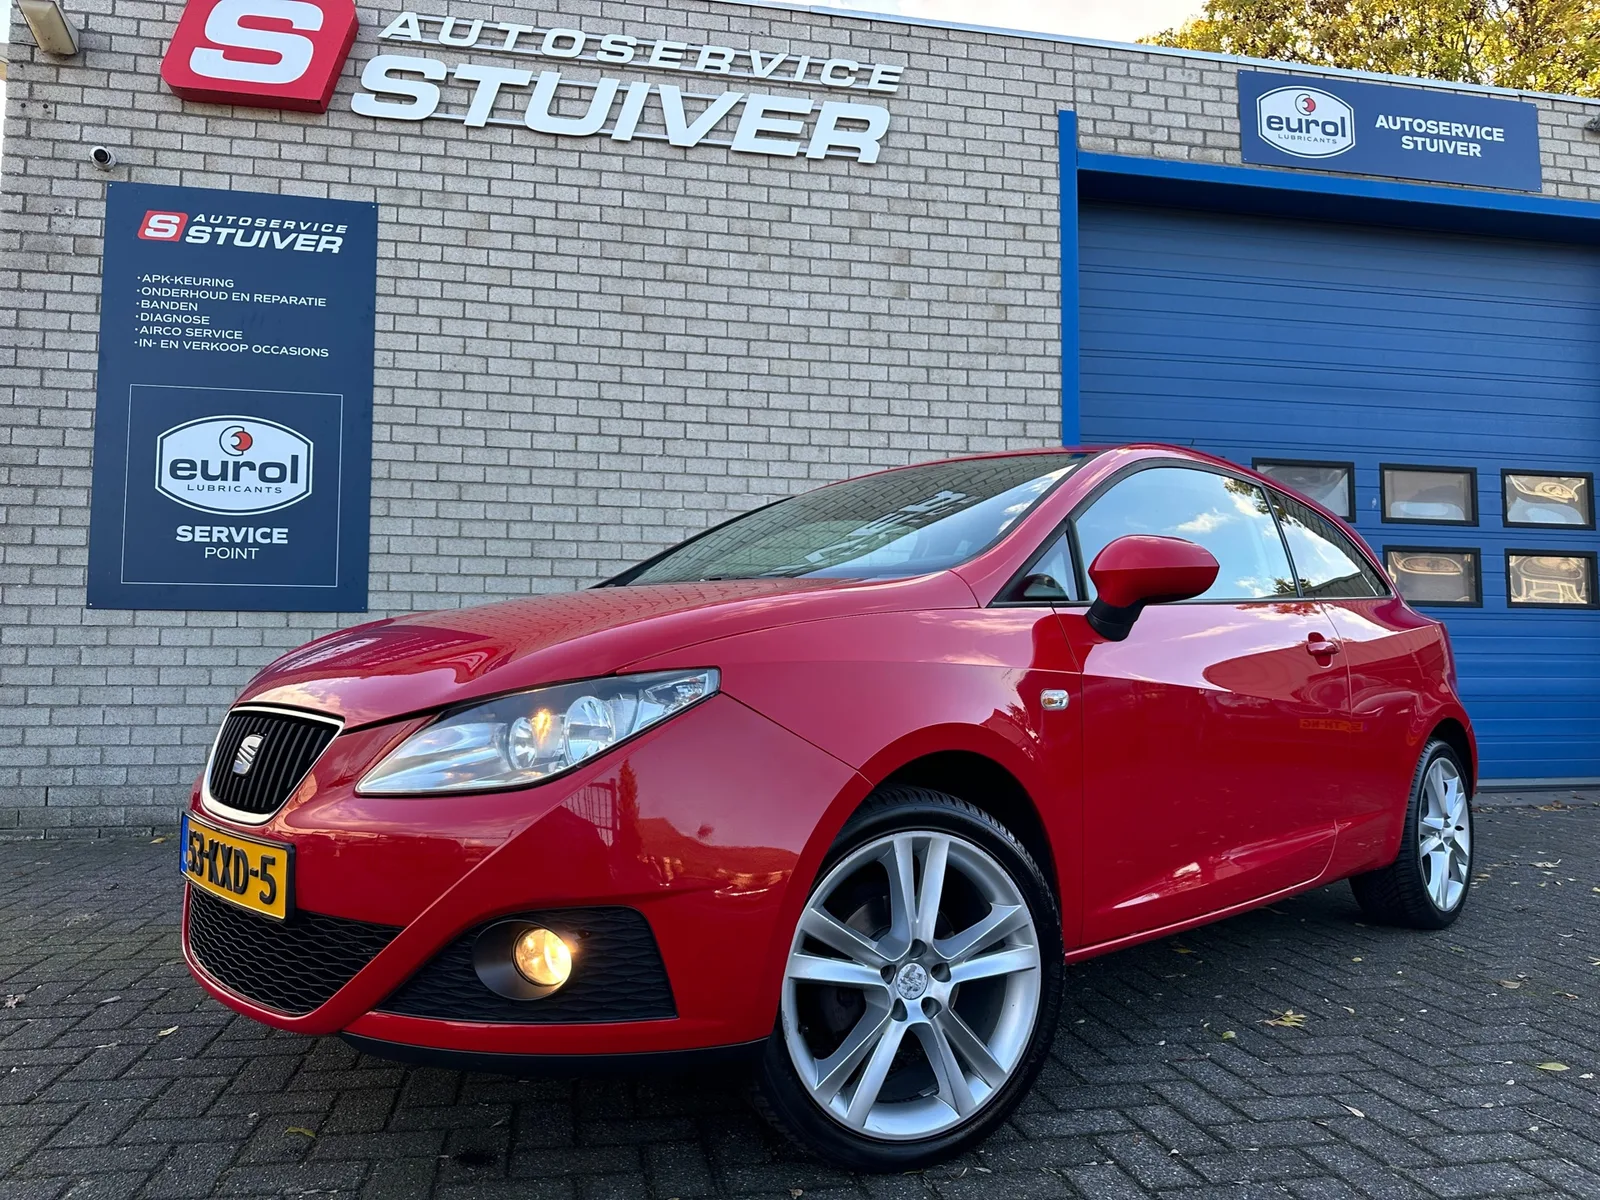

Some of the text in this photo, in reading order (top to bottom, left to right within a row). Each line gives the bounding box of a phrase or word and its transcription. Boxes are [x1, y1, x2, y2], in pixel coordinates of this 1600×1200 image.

[378, 11, 904, 92] AUTOSERVICE
[351, 54, 890, 163] STUIVER
[1266, 114, 1346, 138] eurol
[1375, 114, 1505, 142] AUTOSERVICE
[1278, 133, 1338, 145] LUBRICANTS
[1401, 135, 1482, 157] STUIVER
[192, 213, 348, 234] AUTOSERVICE
[185, 225, 344, 254] STUIVER
[141, 274, 234, 288] APK-KEURING
[141, 287, 327, 307] ONDERHOUD EN REPARATIE
[141, 300, 198, 311] BANDEN
[140, 312, 210, 325] DIAGNOSE
[139, 325, 243, 340] AIRCO SERVICE
[139, 338, 329, 358] IN- EN VERKOOP OCCASIONS
[169, 454, 299, 484] eurol
[187, 484, 282, 494] LUBRICANTS
[175, 525, 289, 544] SERVICE
[204, 547, 260, 560] POINT
[187, 829, 277, 906] 53-KXD-5
